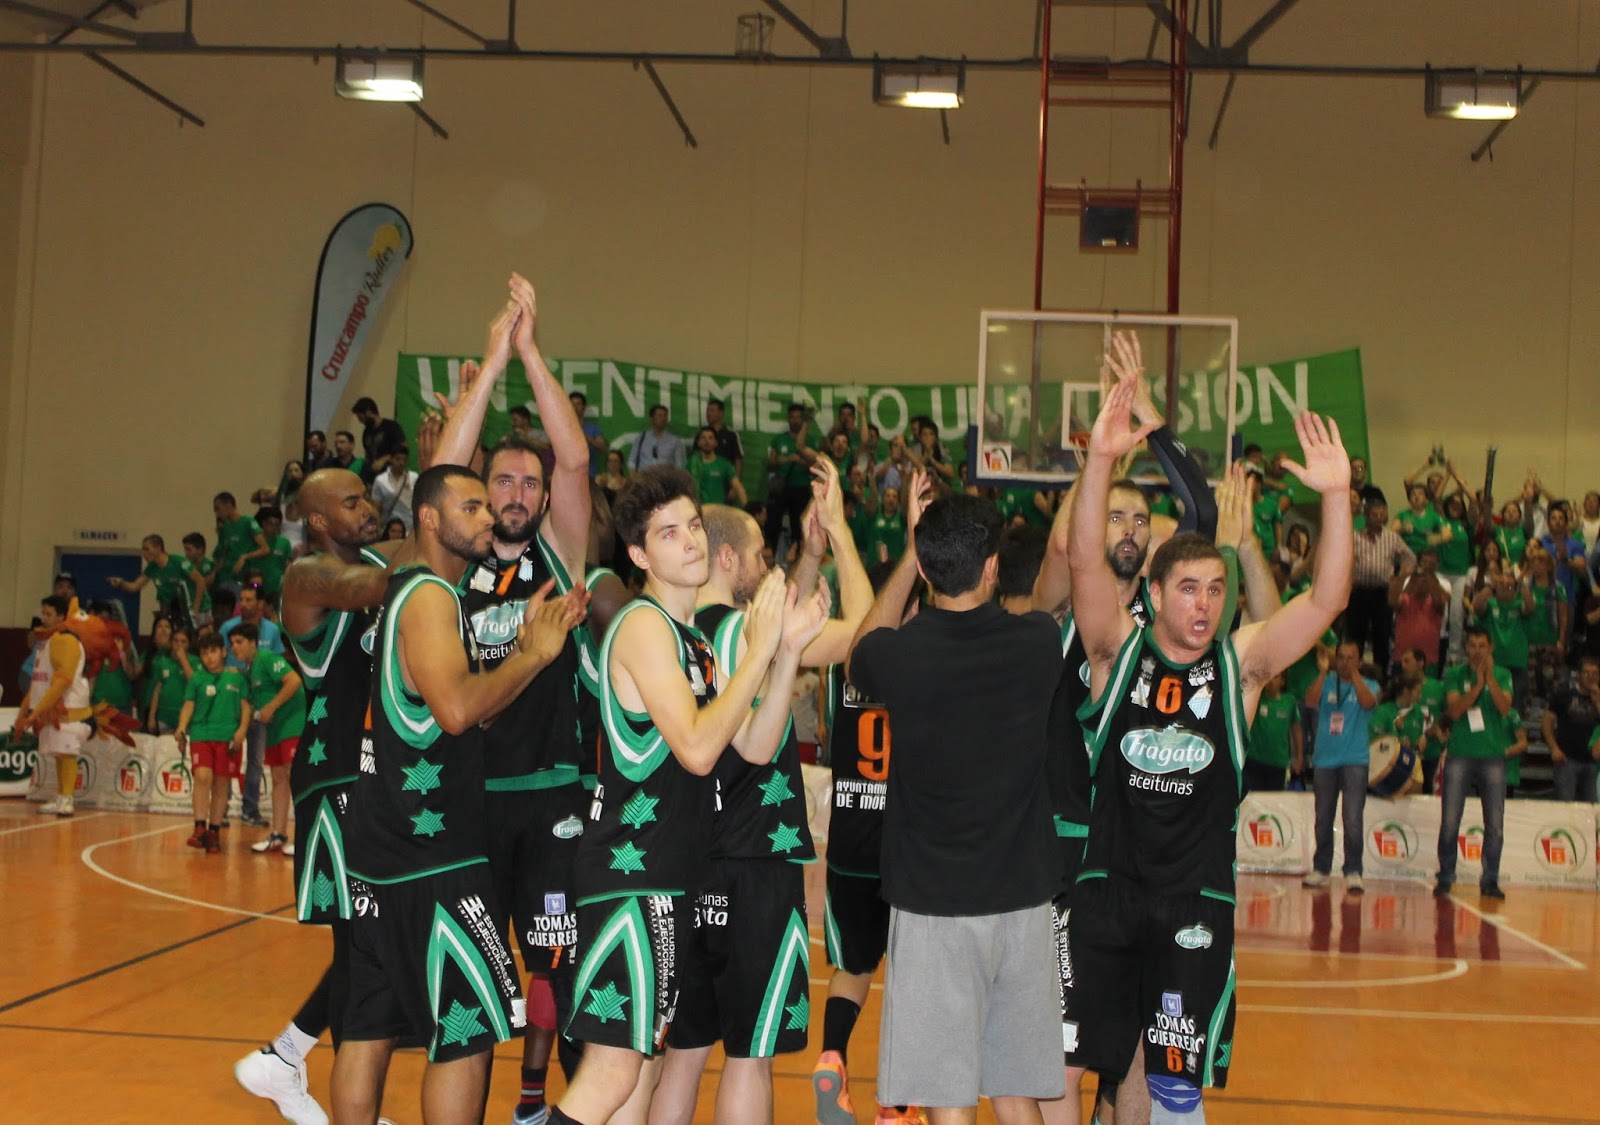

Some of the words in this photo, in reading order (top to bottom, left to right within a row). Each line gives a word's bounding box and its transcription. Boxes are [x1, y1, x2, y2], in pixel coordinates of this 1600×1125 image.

[321, 294, 370, 382] Cruzcampo
[525, 358, 909, 442] ENTIMIENTO
[1155, 676, 1183, 715] 6
[857, 707, 892, 781] 9
[1128, 774, 1194, 796] aceitunas
[836, 792, 854, 808] DE
[533, 913, 577, 932] TOMAS
[527, 928, 578, 947] GUERRER
[668, 917, 676, 968] ESTUDIOS
[549, 946, 563, 969] 7
[1060, 931, 1072, 980] ESTUDIOS
[669, 970, 675, 978] Y
[1064, 980, 1074, 988] Y
[1155, 1012, 1196, 1035] TOMAS
[1166, 1046, 1183, 1073] 6
